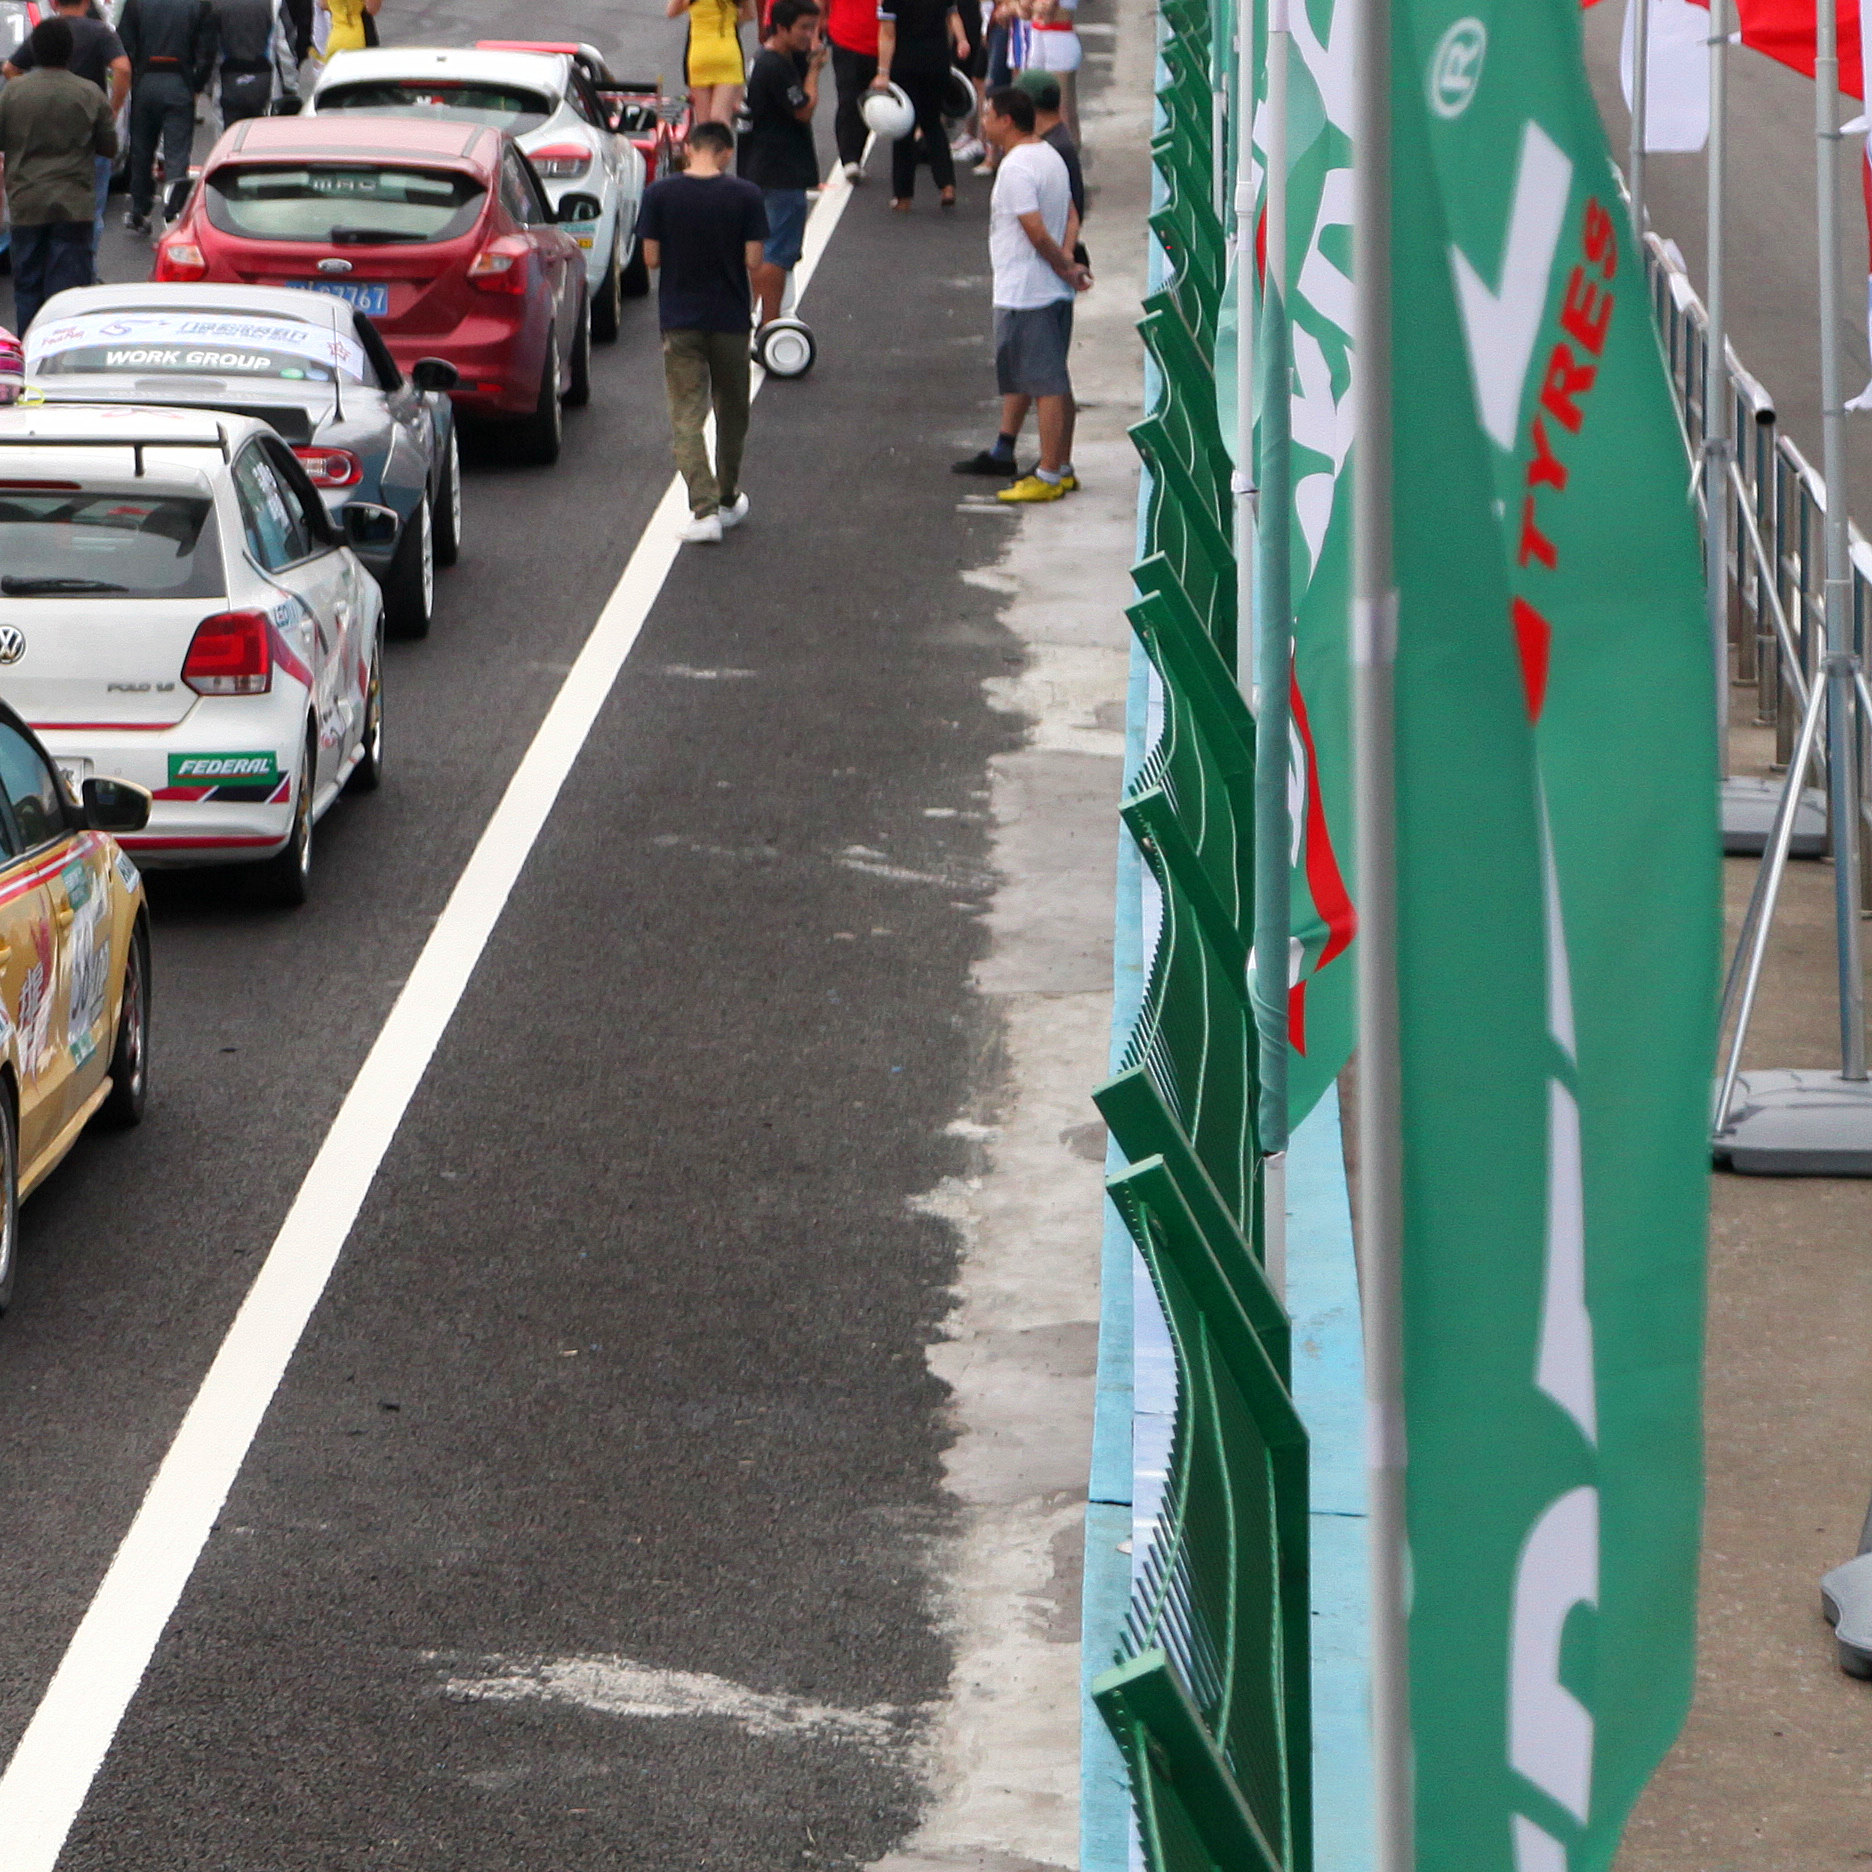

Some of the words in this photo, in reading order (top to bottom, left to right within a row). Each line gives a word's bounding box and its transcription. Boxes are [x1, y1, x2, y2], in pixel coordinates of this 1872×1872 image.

[106, 349, 182, 367] WORK
[186, 350, 272, 370] GROUP
[1517, 194, 1618, 571] TYRES
[178, 757, 272, 776] FEDERAL
